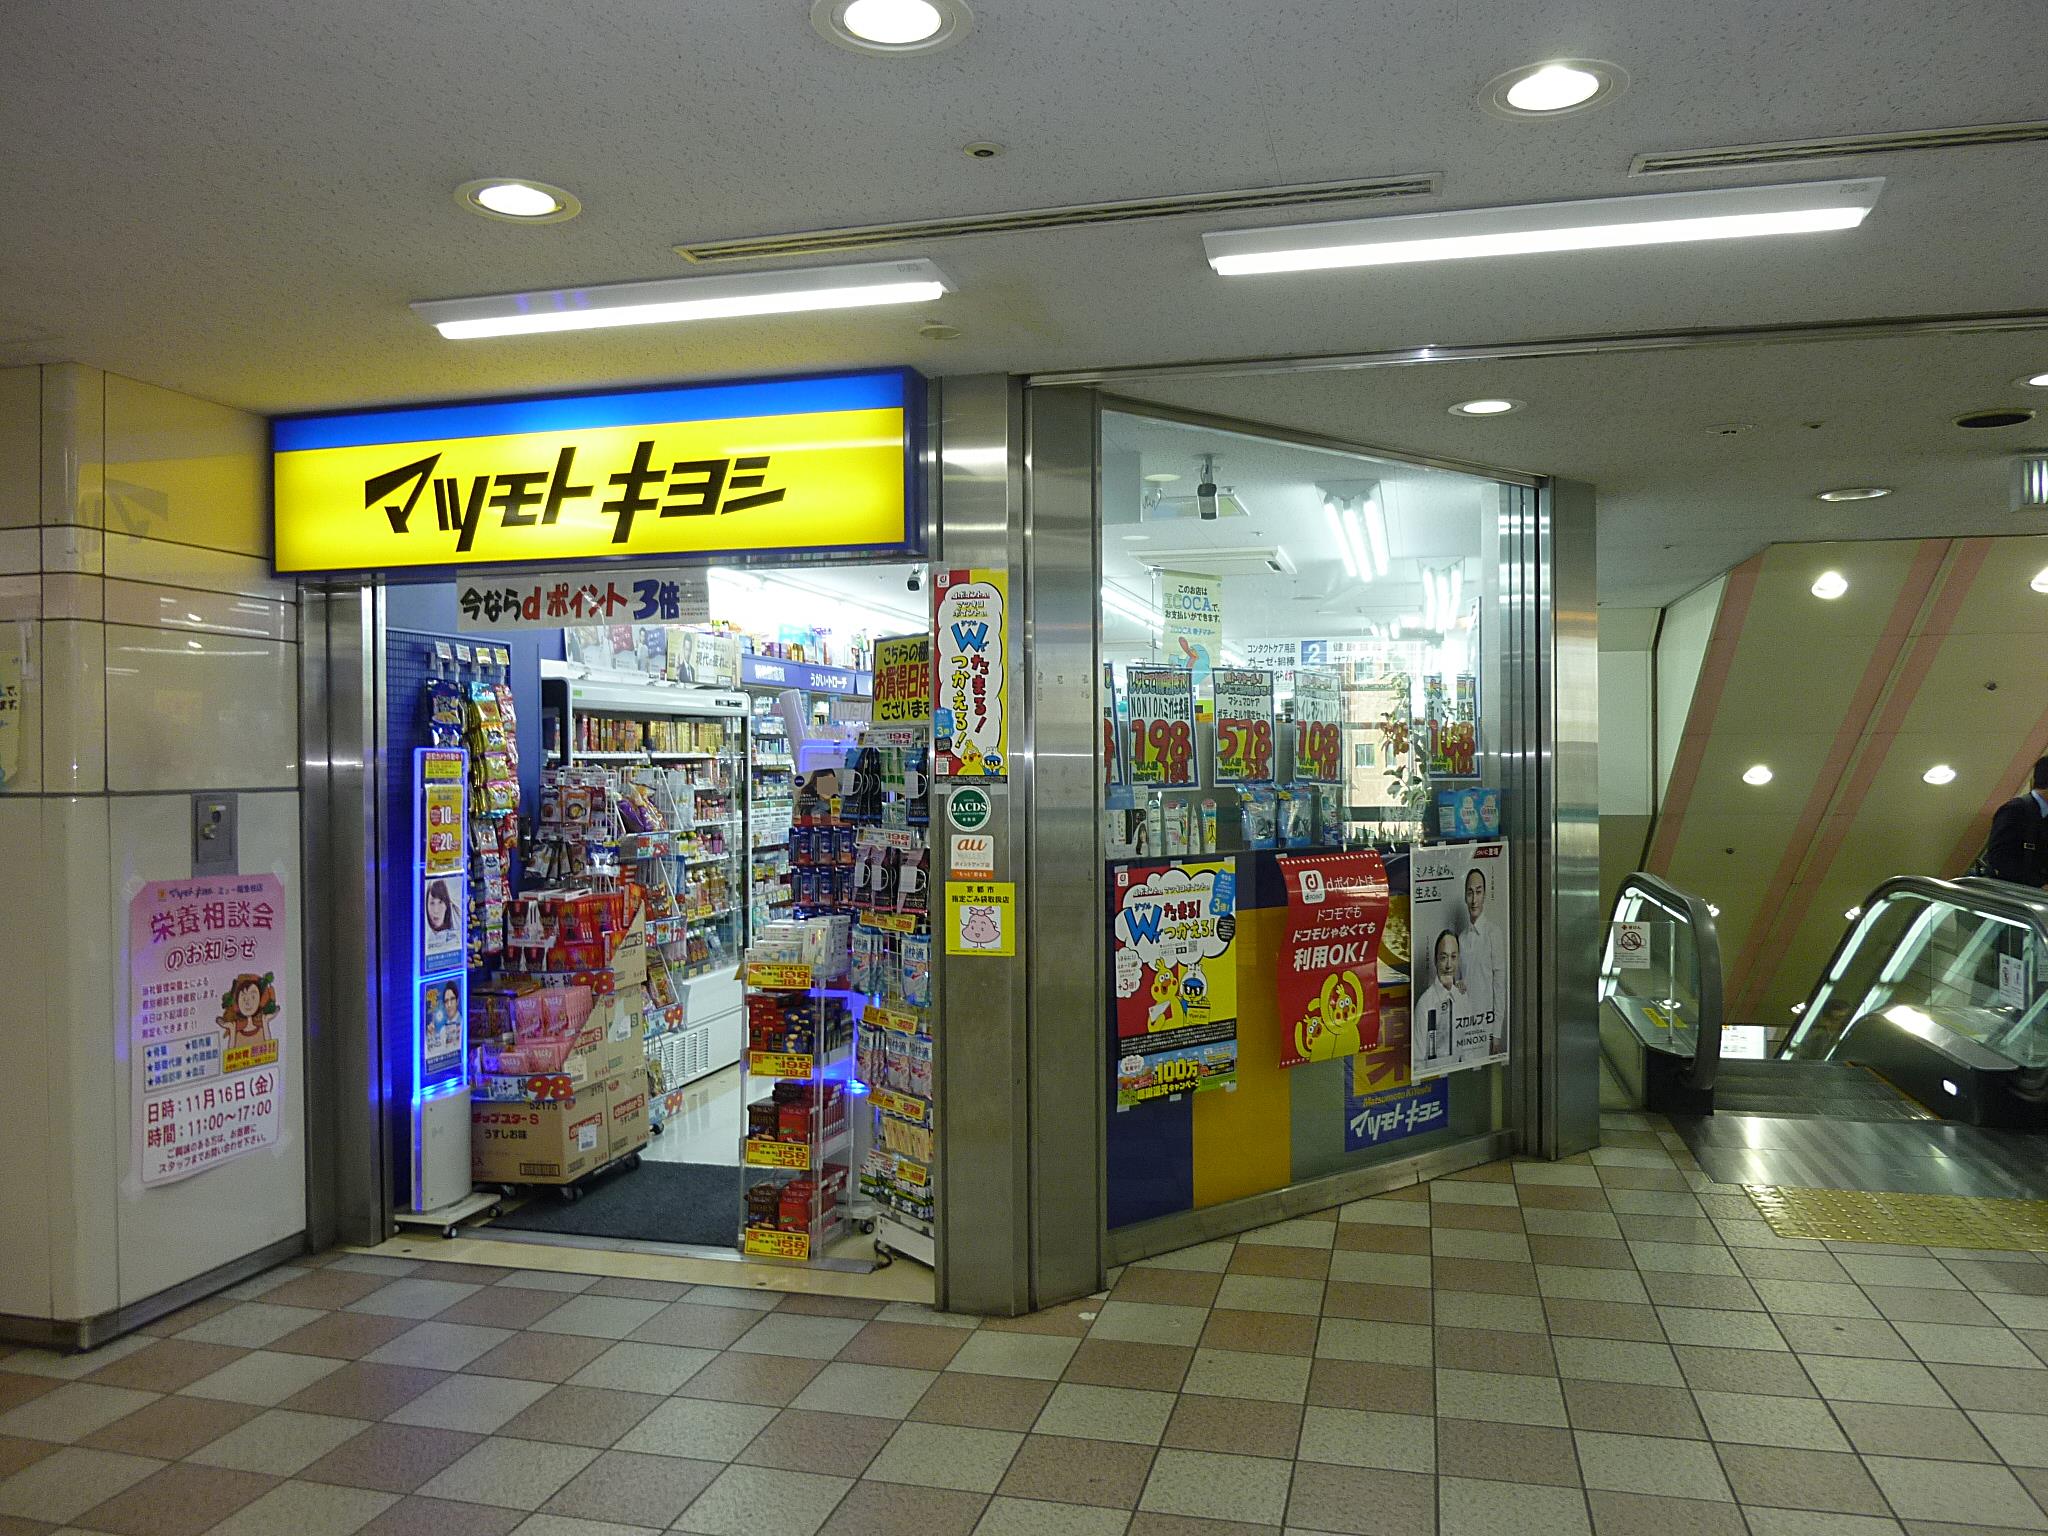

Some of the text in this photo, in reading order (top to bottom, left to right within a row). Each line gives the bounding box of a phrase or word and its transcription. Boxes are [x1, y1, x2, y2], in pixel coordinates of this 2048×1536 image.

[364, 440, 787, 552] マツモトキヨシ
[1178, 584, 1208, 596] このお店は
[1165, 609, 1221, 623] お支払いができます。
[1247, 643, 1296, 654] コンタクトケア用品
[1307, 643, 1321, 664] 2
[951, 655, 970, 749] つかえる!
[1131, 718, 1193, 764] 198
[1217, 717, 1273, 763] 578
[1296, 718, 1340, 763] 108
[951, 802, 987, 812] JACDS
[957, 838, 988, 851] au
[1415, 864, 1454, 878] ミノキなら、
[966, 885, 995, 893] 京都市
[1326, 874, 1375, 892] dポイントは
[1415, 886, 1441, 899] 生える。
[951, 894, 1010, 904] 指定ごみ袋取扱店
[1163, 899, 1202, 922] たまる!
[1317, 904, 1362, 923] ドコモでも
[150, 901, 275, 944] 栄養相談会
[1163, 917, 1216, 941] つかえる!
[1292, 921, 1377, 944] ドコモじゃなくても
[165, 936, 257, 971] のお知らせ
[1293, 940, 1369, 972] 利用OK!
[778, 970, 809, 979] 198
[1455, 1010, 1496, 1030] スカルプD
[780, 1060, 810, 1070] 198
[527, 1075, 575, 1101] 98
[148, 1073, 274, 1125] 日時:11月16日(金)
[1350, 1099, 1443, 1141] マツモトキヨシ
[484, 1129, 528, 1140] うすしお味
[777, 1150, 807, 1160] 158
[776, 1238, 806, 1248] 158
